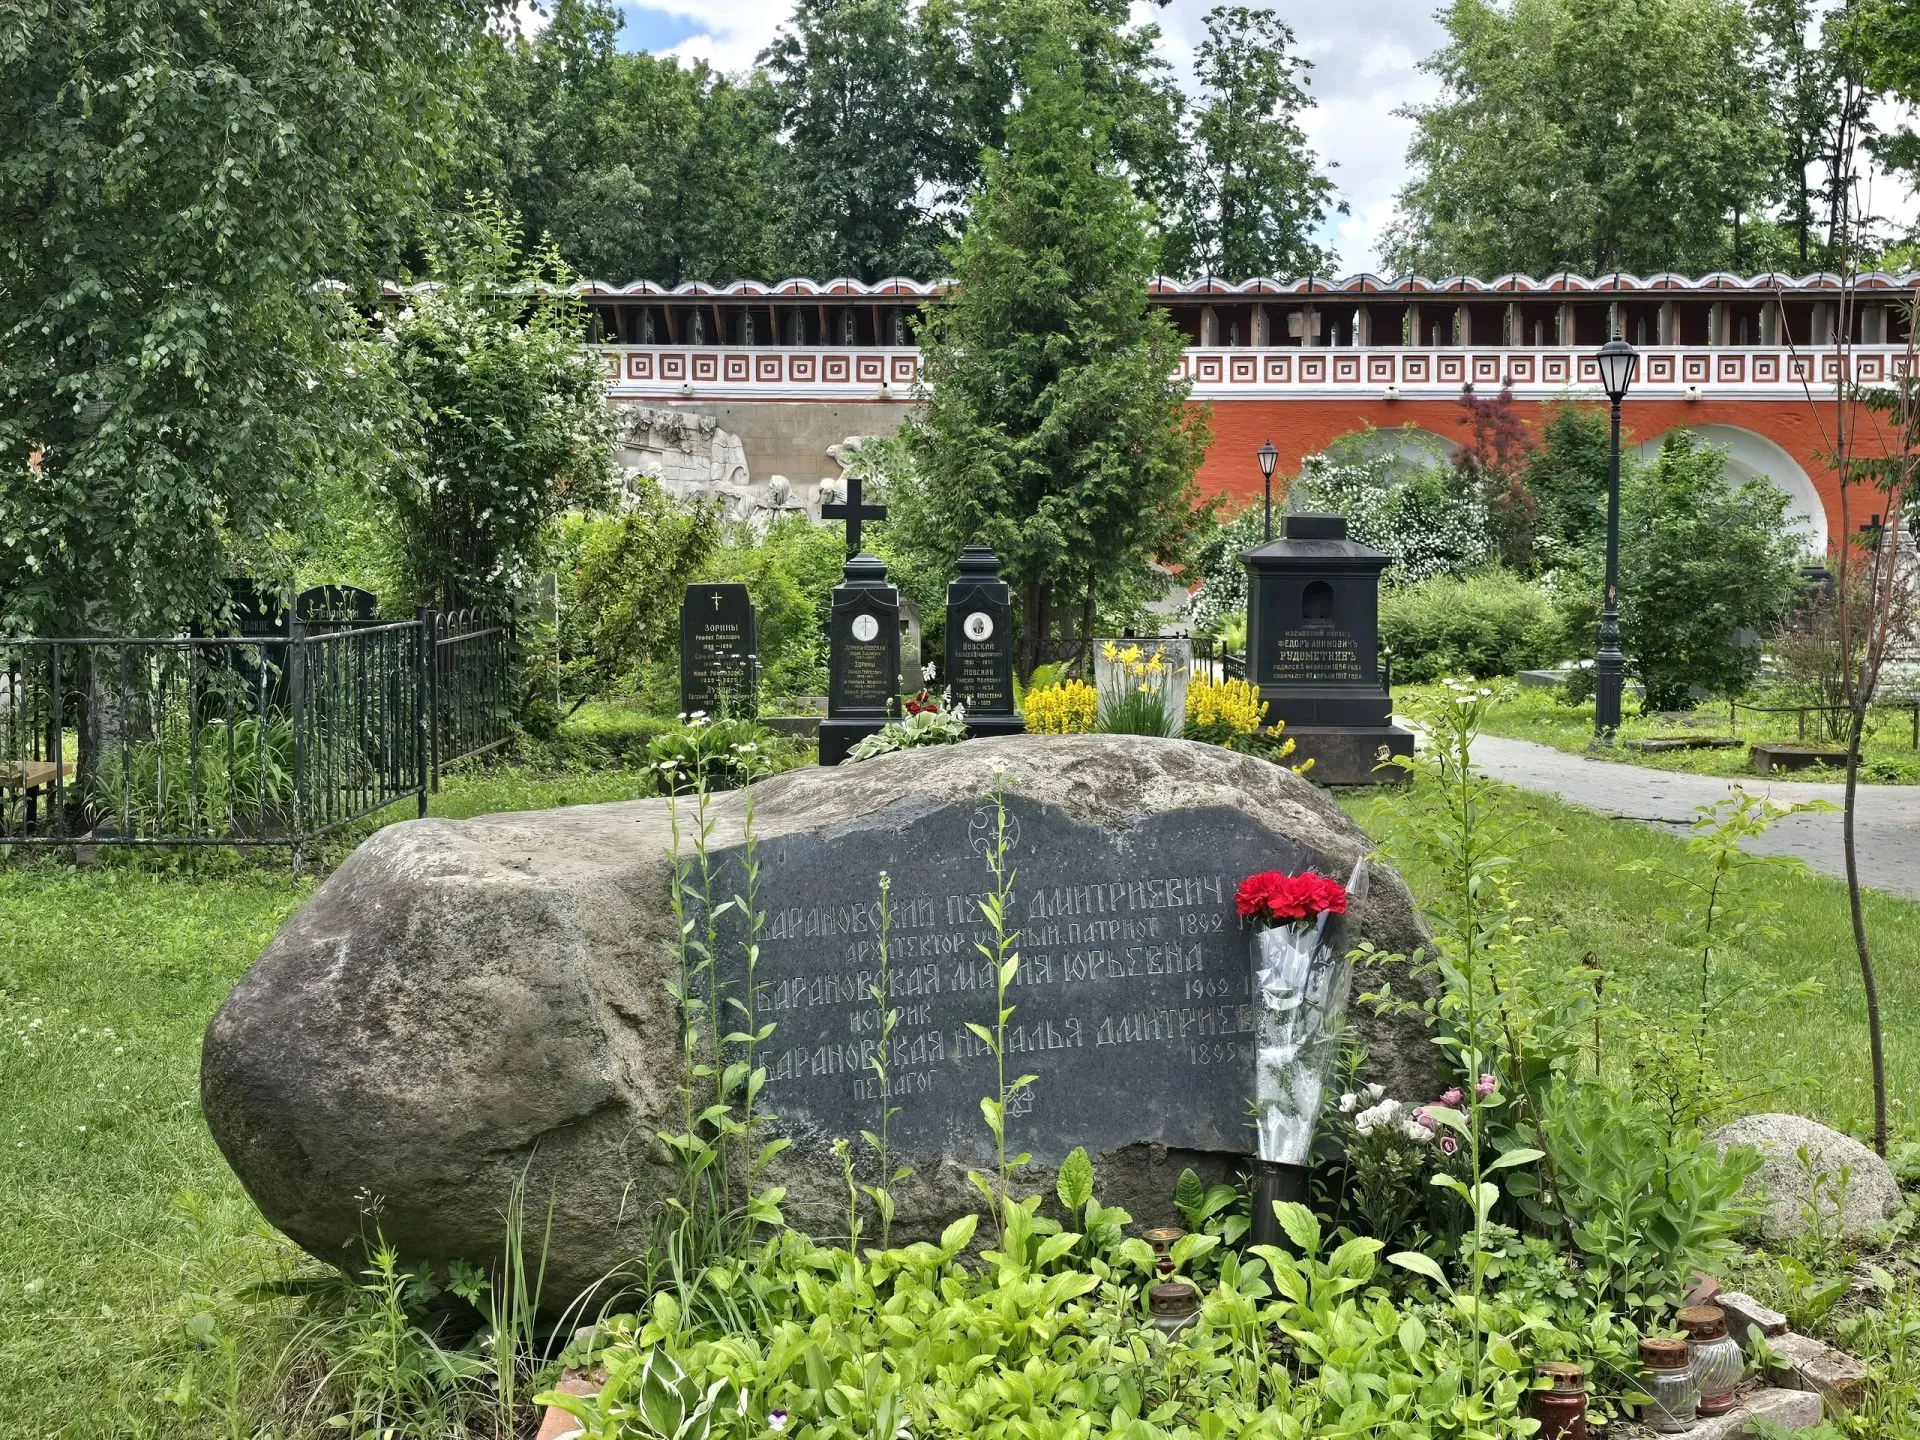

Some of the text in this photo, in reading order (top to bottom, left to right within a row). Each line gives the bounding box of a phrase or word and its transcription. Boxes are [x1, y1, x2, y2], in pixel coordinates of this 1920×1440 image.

[704, 624, 740, 632] ЗОРИНЫ
[755, 892, 935, 941] БАРАНОВСКИЙ
[1028, 874, 1223, 921] ДМИТРИЕВИЧ
[1069, 917, 1158, 944] ПАТРИОТ
[1178, 914, 1224, 935] 1892
[757, 942, 1203, 1011] БАРАНОВСКАЯ МАИЯ ЮРЬЕВНА
[1185, 977, 1229, 999] 1902
[758, 1030, 945, 1081] БАРАНОВСКАЯ
[853, 1041, 1236, 1100] ПЕДАГОГ 1895
